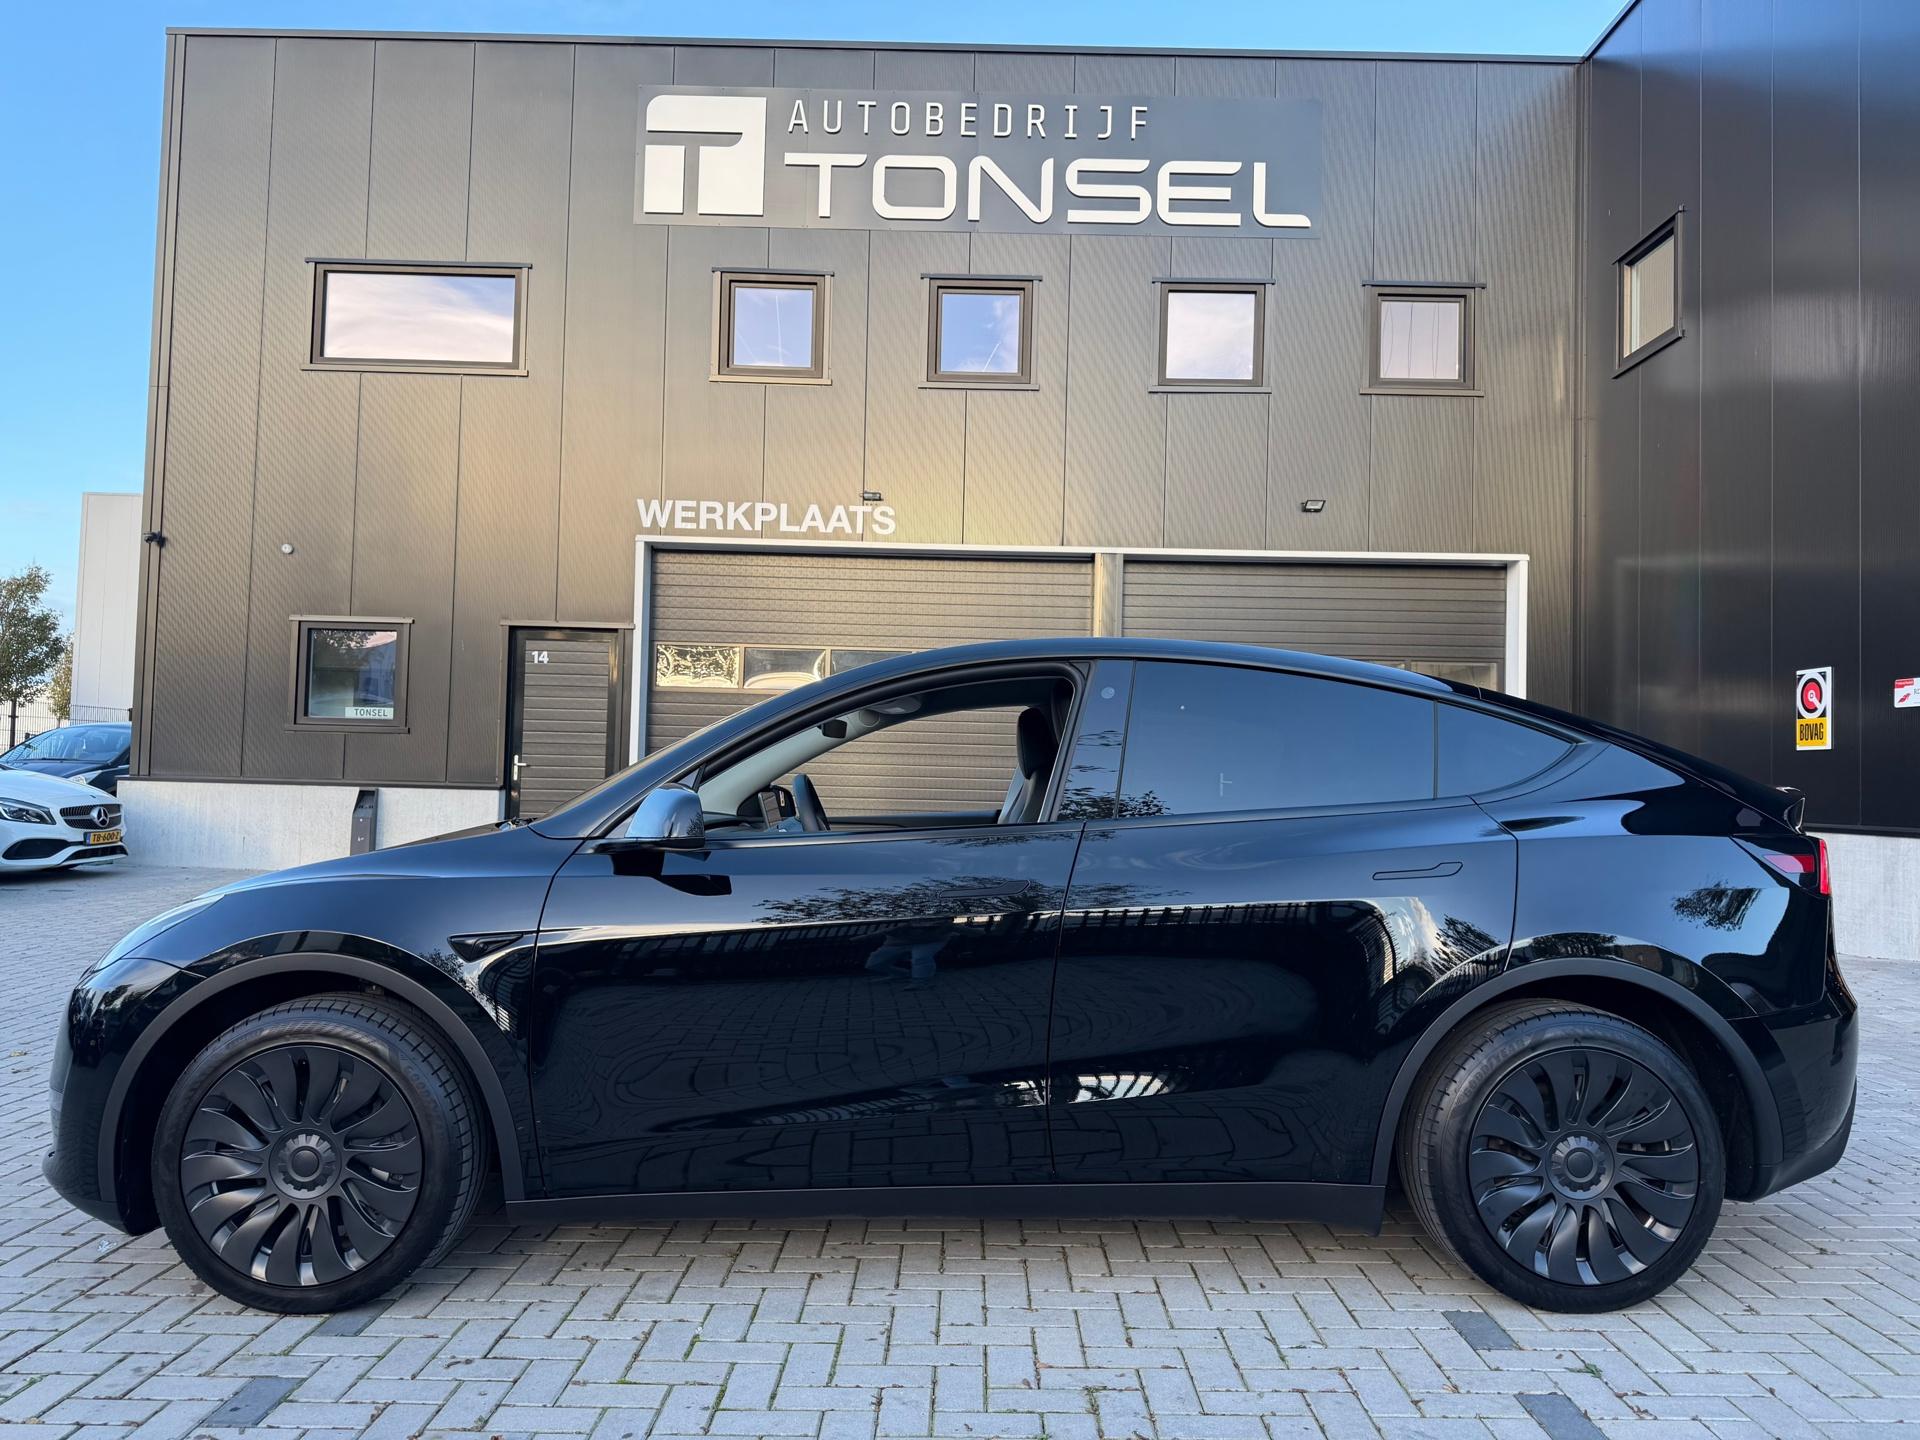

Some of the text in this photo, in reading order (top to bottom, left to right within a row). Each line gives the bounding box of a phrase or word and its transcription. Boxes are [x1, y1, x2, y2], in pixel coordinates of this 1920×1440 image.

[788, 99, 1148, 140] AUTOBEDRIJF
[784, 152, 1311, 228] TONSEL
[637, 499, 896, 535] WERKPLAATS
[531, 651, 549, 664] 14
[354, 708, 388, 717] TONSEL
[1800, 722, 1824, 741] BOVAG
